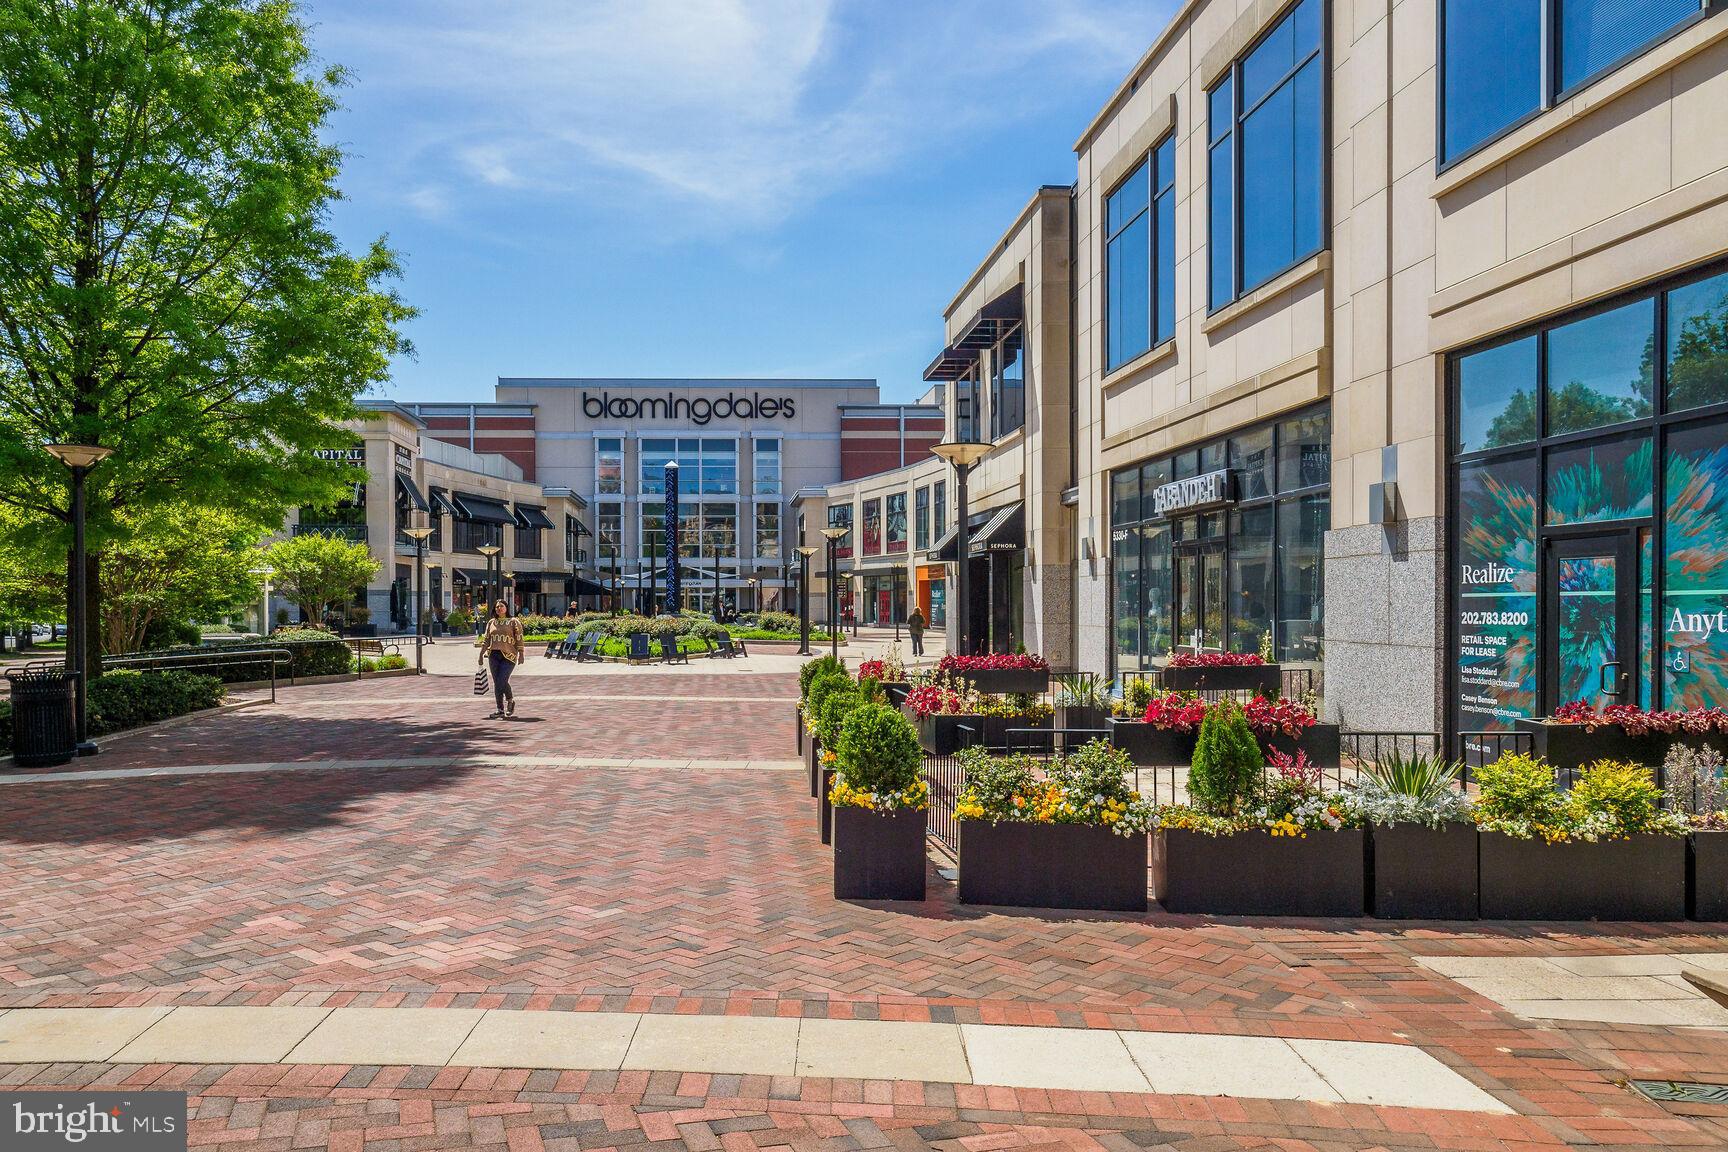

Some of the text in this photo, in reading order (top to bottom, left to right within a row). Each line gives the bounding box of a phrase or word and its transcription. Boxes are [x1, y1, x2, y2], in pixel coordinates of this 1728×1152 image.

[582, 391, 796, 426] bloomingdale's
[1153, 474, 1219, 514] TABANDEH
[1461, 562, 1514, 585] Realize
[1461, 611, 1529, 626] 202.783.8200
[1667, 605, 1728, 640] Anyt
[1461, 635, 1507, 646] RETAIL SPACE
[1461, 646, 1497, 657] FOR LEASE
[1461, 666, 1498, 676] Lisa Stoddard
[1461, 675, 1520, 688] lisa.stoddard@cbre.com
[1461, 693, 1498, 705] Casey Benson
[1461, 704, 1522, 718] casey.benson@cbre.com
[1465, 740, 1491, 754] bre.cm
